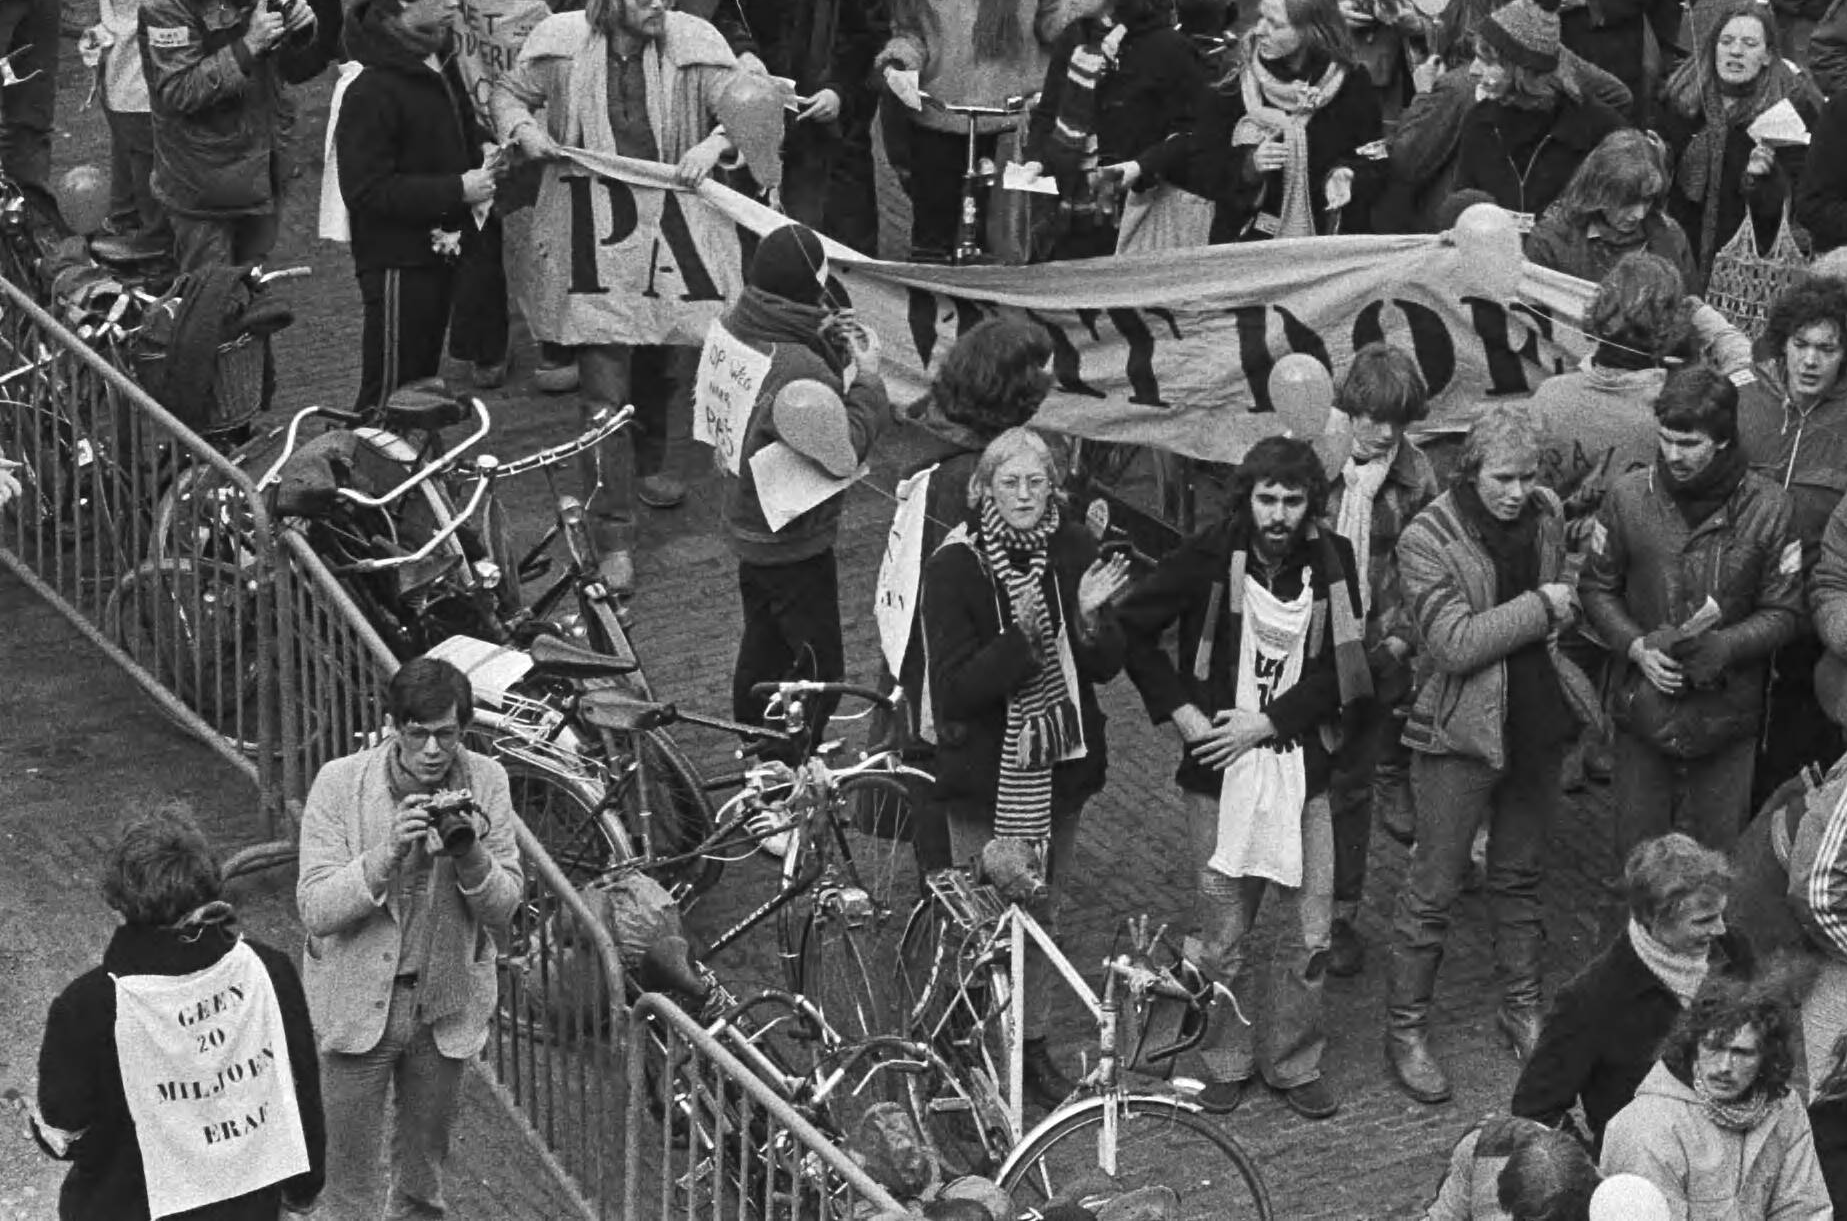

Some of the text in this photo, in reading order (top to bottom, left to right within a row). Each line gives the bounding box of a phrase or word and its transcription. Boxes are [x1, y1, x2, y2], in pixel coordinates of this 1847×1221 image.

[178, 984, 245, 1027] GEEN
[197, 1028, 226, 1054] 20
[157, 1041, 275, 1102] MILJOEN
